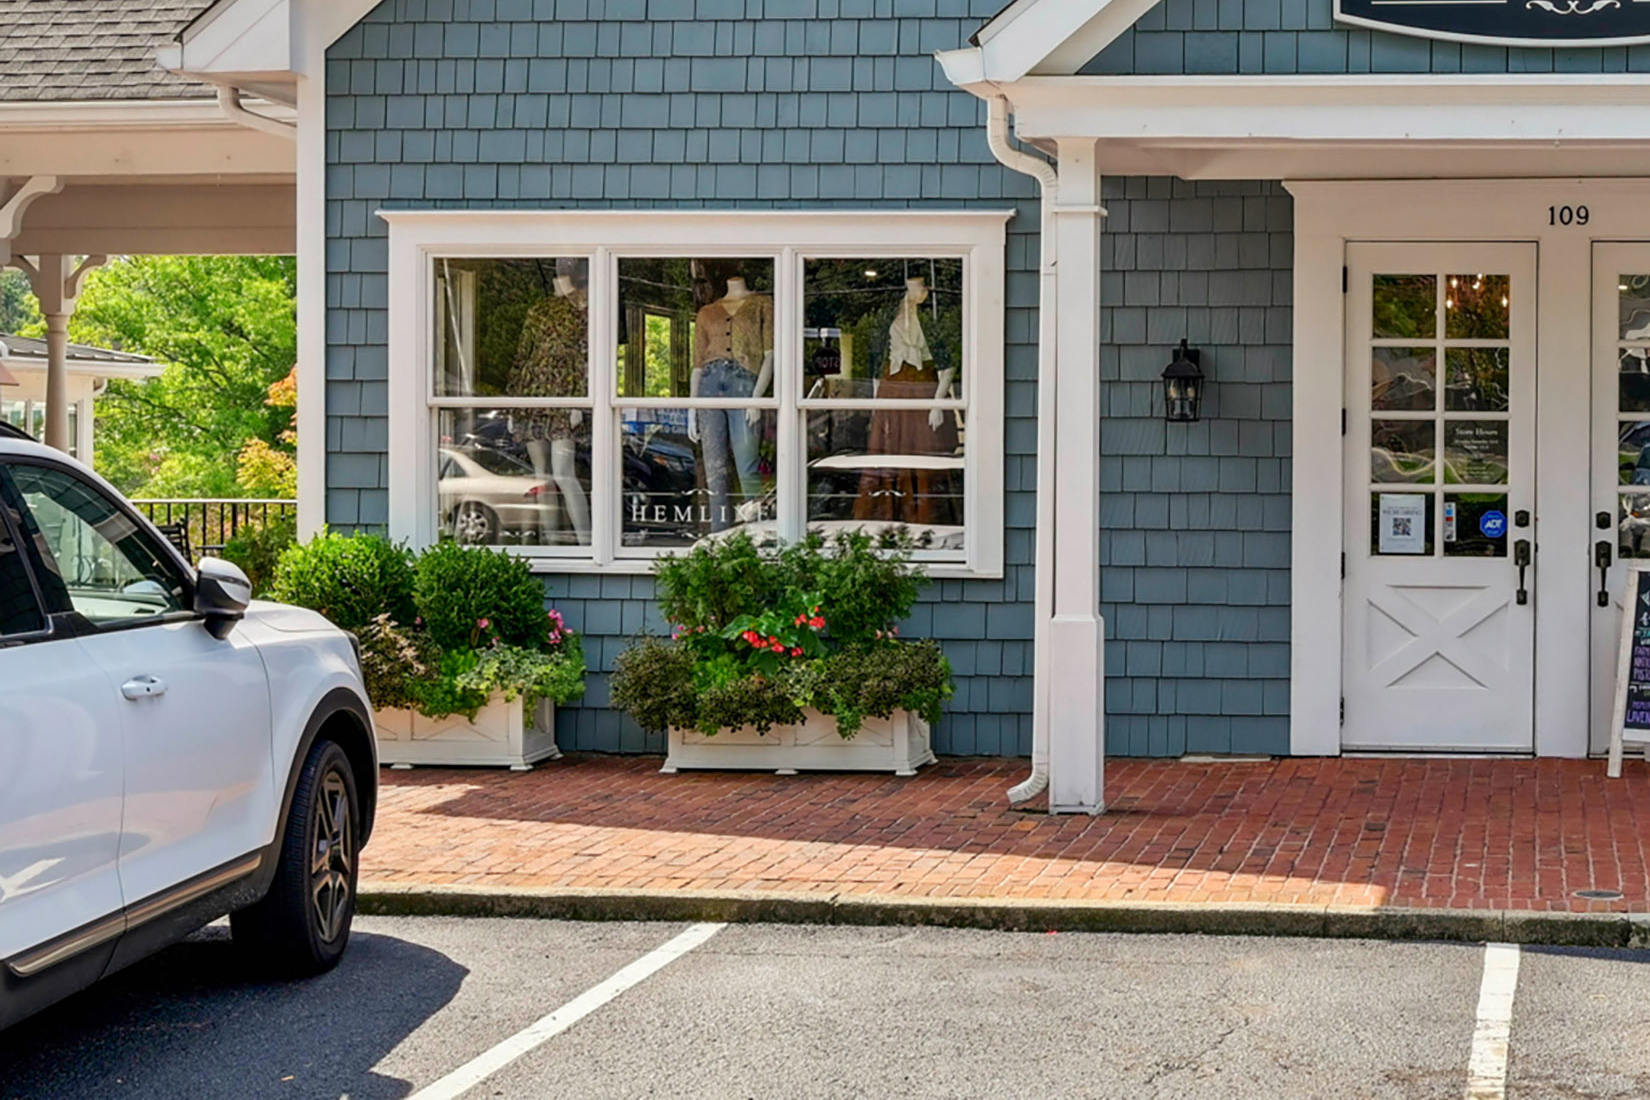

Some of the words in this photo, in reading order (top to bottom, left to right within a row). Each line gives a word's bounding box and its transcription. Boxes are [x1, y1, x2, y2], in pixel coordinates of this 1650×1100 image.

[1549, 205, 1589, 226] 109
[632, 504, 769, 523] HEMLINE
[1484, 519, 1503, 529] ADT
